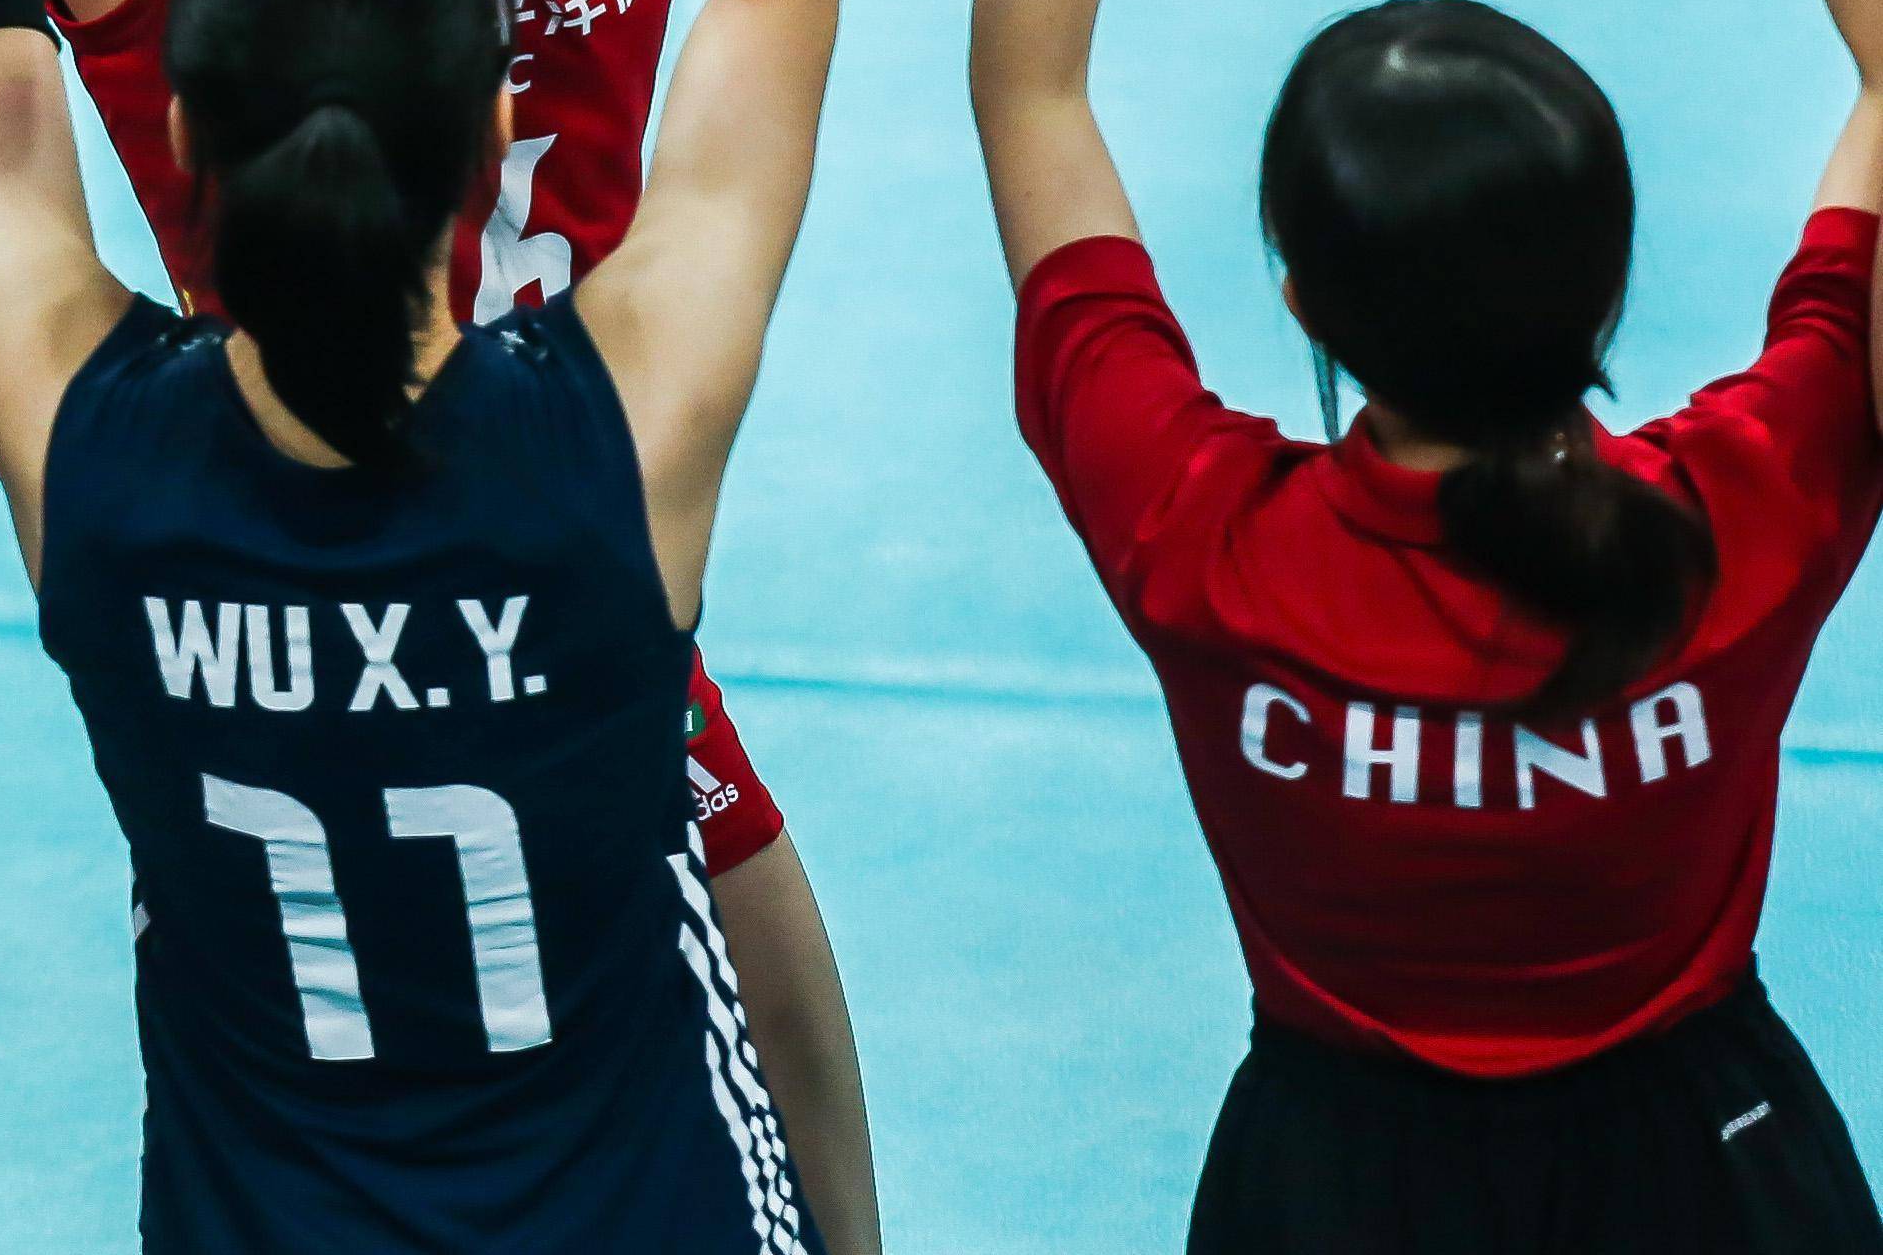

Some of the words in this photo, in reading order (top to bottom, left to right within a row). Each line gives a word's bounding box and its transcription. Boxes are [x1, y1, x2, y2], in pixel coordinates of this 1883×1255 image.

[142, 595, 315, 712] WU
[339, 602, 451, 712] X.
[455, 594, 548, 702] Y.
[1239, 680, 1713, 811] CHINA
[200, 772, 553, 1061] 11
